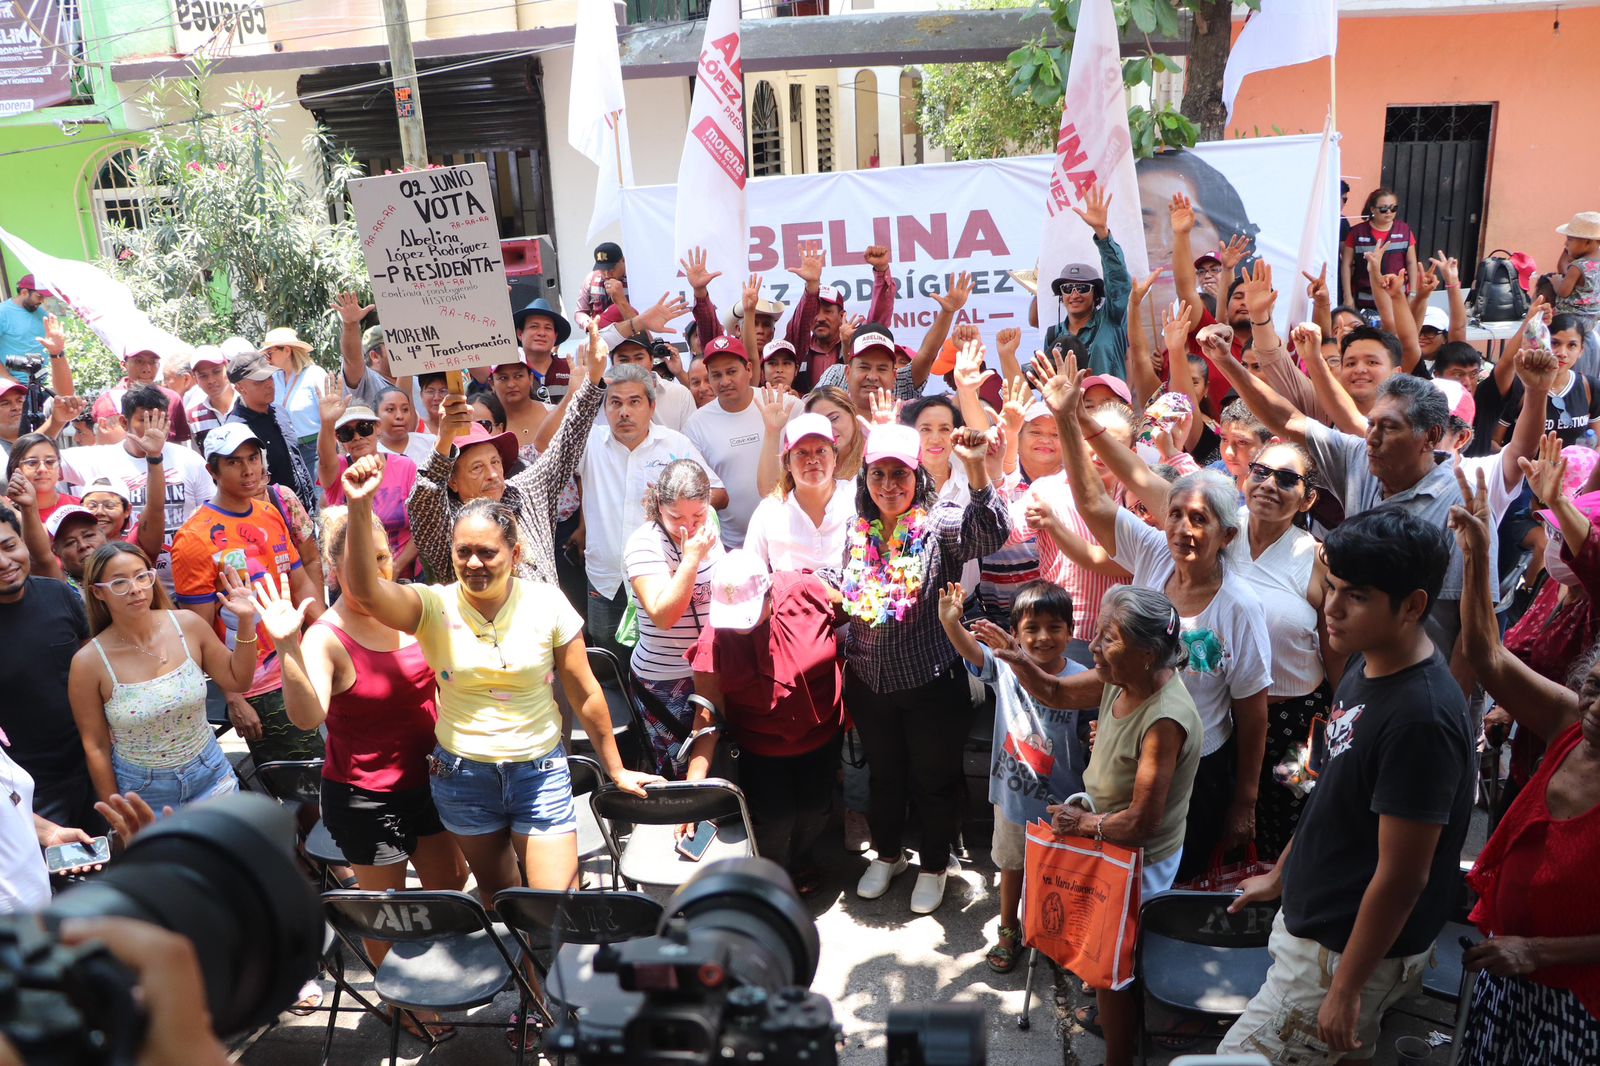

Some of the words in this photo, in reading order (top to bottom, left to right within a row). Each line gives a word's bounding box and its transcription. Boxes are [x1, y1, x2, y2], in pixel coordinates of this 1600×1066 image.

[699, 50, 742, 106] LÓPEZ
[705, 127, 746, 176] morena
[400, 179, 426, 198] 02
[429, 167, 474, 194] JUNIO
[413, 190, 487, 224] VOTA
[400, 228, 460, 247] Abelina
[677, 209, 1011, 277] BELINA
[386, 248, 424, 266] López
[428, 242, 490, 259] Rodríguez
[830, 268, 1014, 302] ODÍGEZ
[384, 325, 441, 345] MORENA
[425, 334, 512, 359] Transformación
